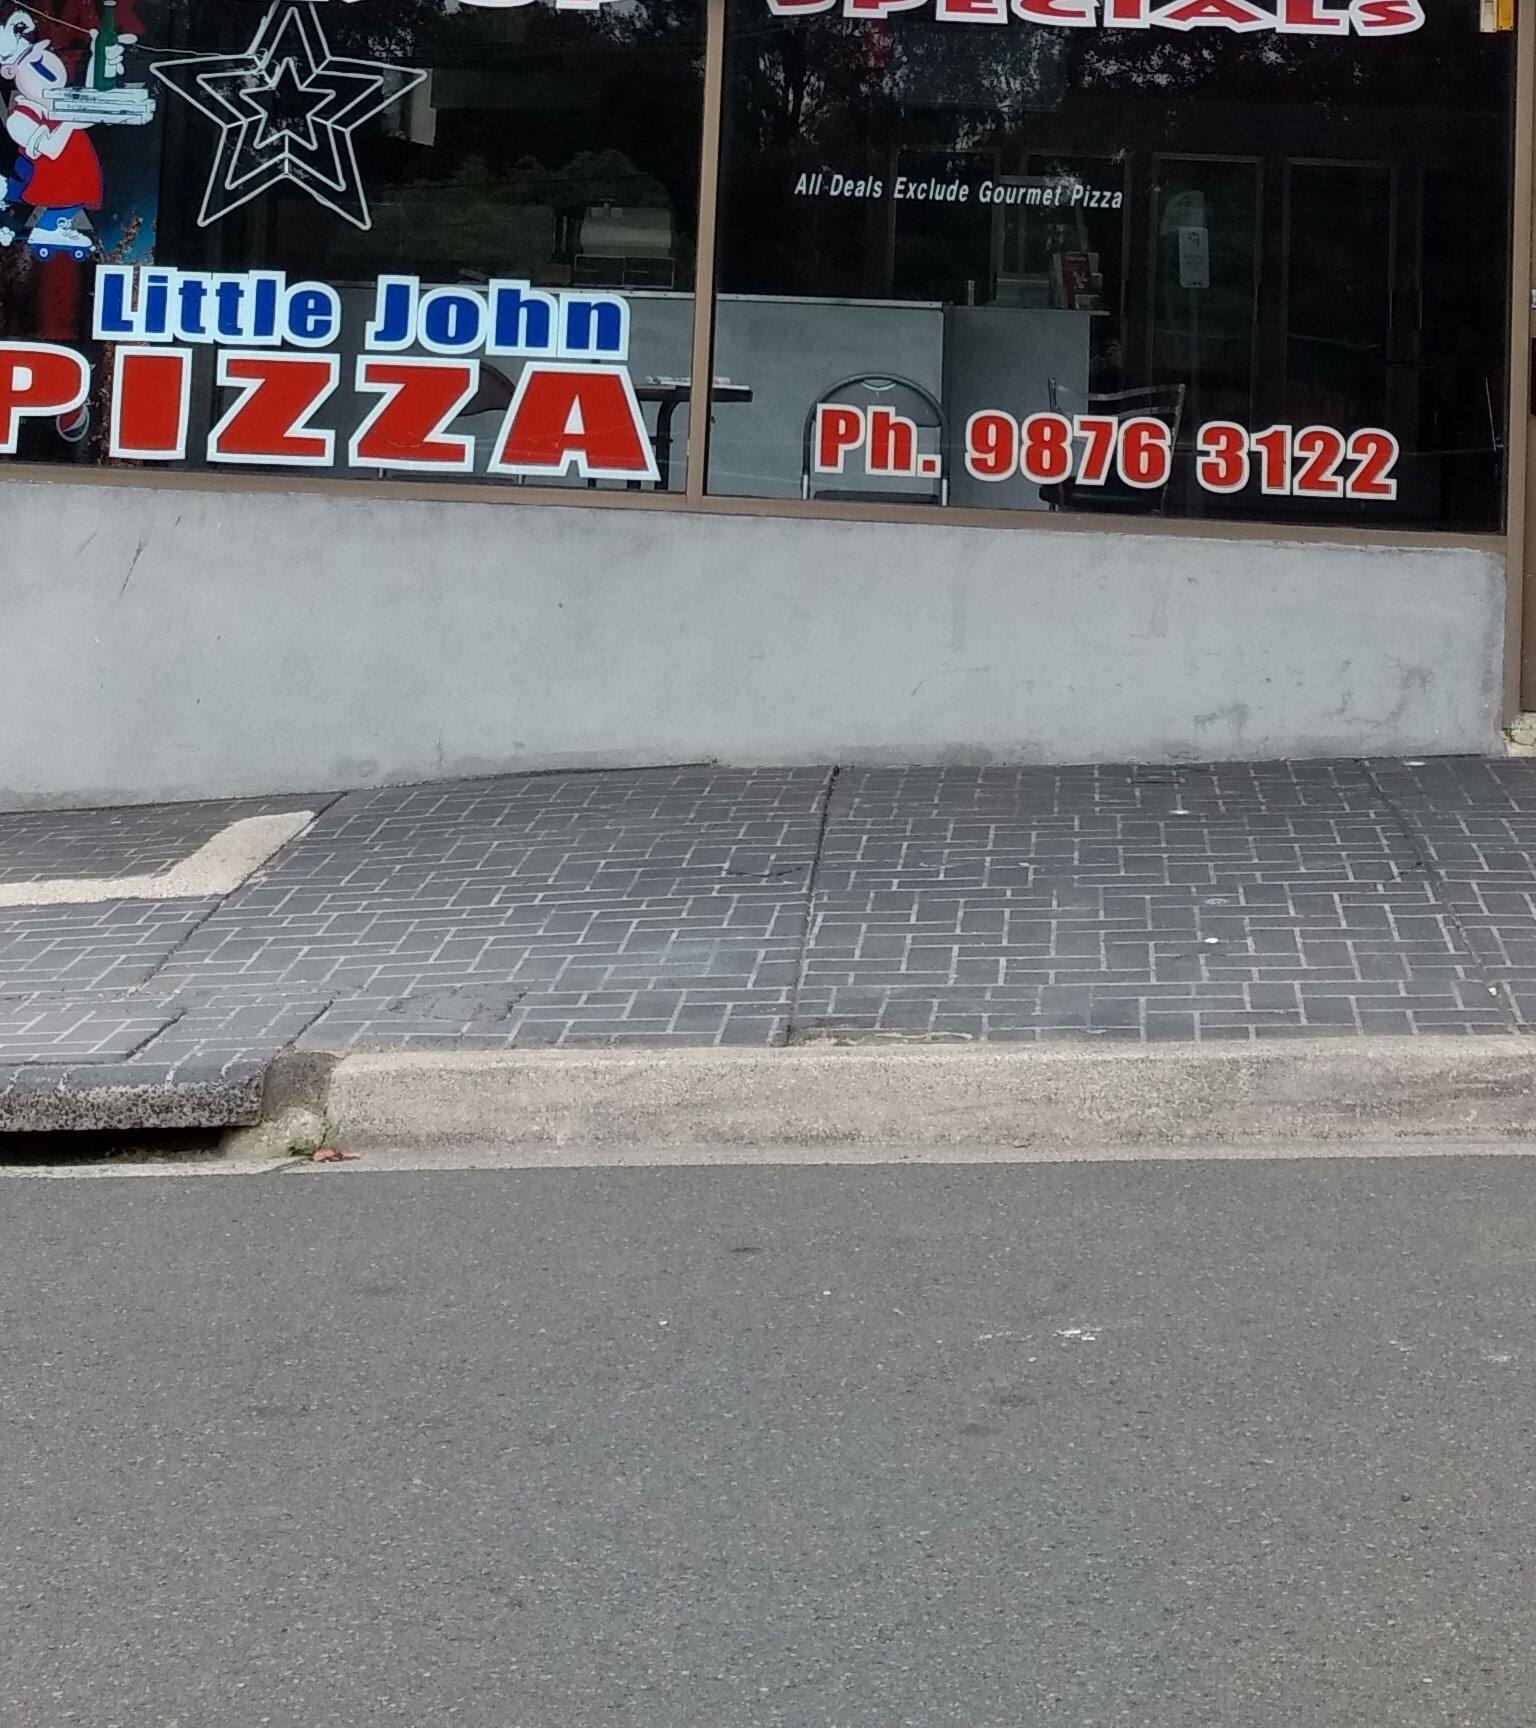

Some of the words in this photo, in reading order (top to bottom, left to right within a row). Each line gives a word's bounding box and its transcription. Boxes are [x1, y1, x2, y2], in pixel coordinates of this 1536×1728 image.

[794, 172, 822, 195] All
[829, 174, 882, 198] Deals
[893, 177, 969, 202] Exclude
[979, 181, 1063, 206] Gourmet
[1070, 185, 1124, 209] Pizza
[92, 264, 341, 347] Little
[365, 274, 629, 361] John
[814, 404, 942, 478] Ph.
[965, 412, 1169, 486] 9876
[1196, 421, 1398, 501] 3122
